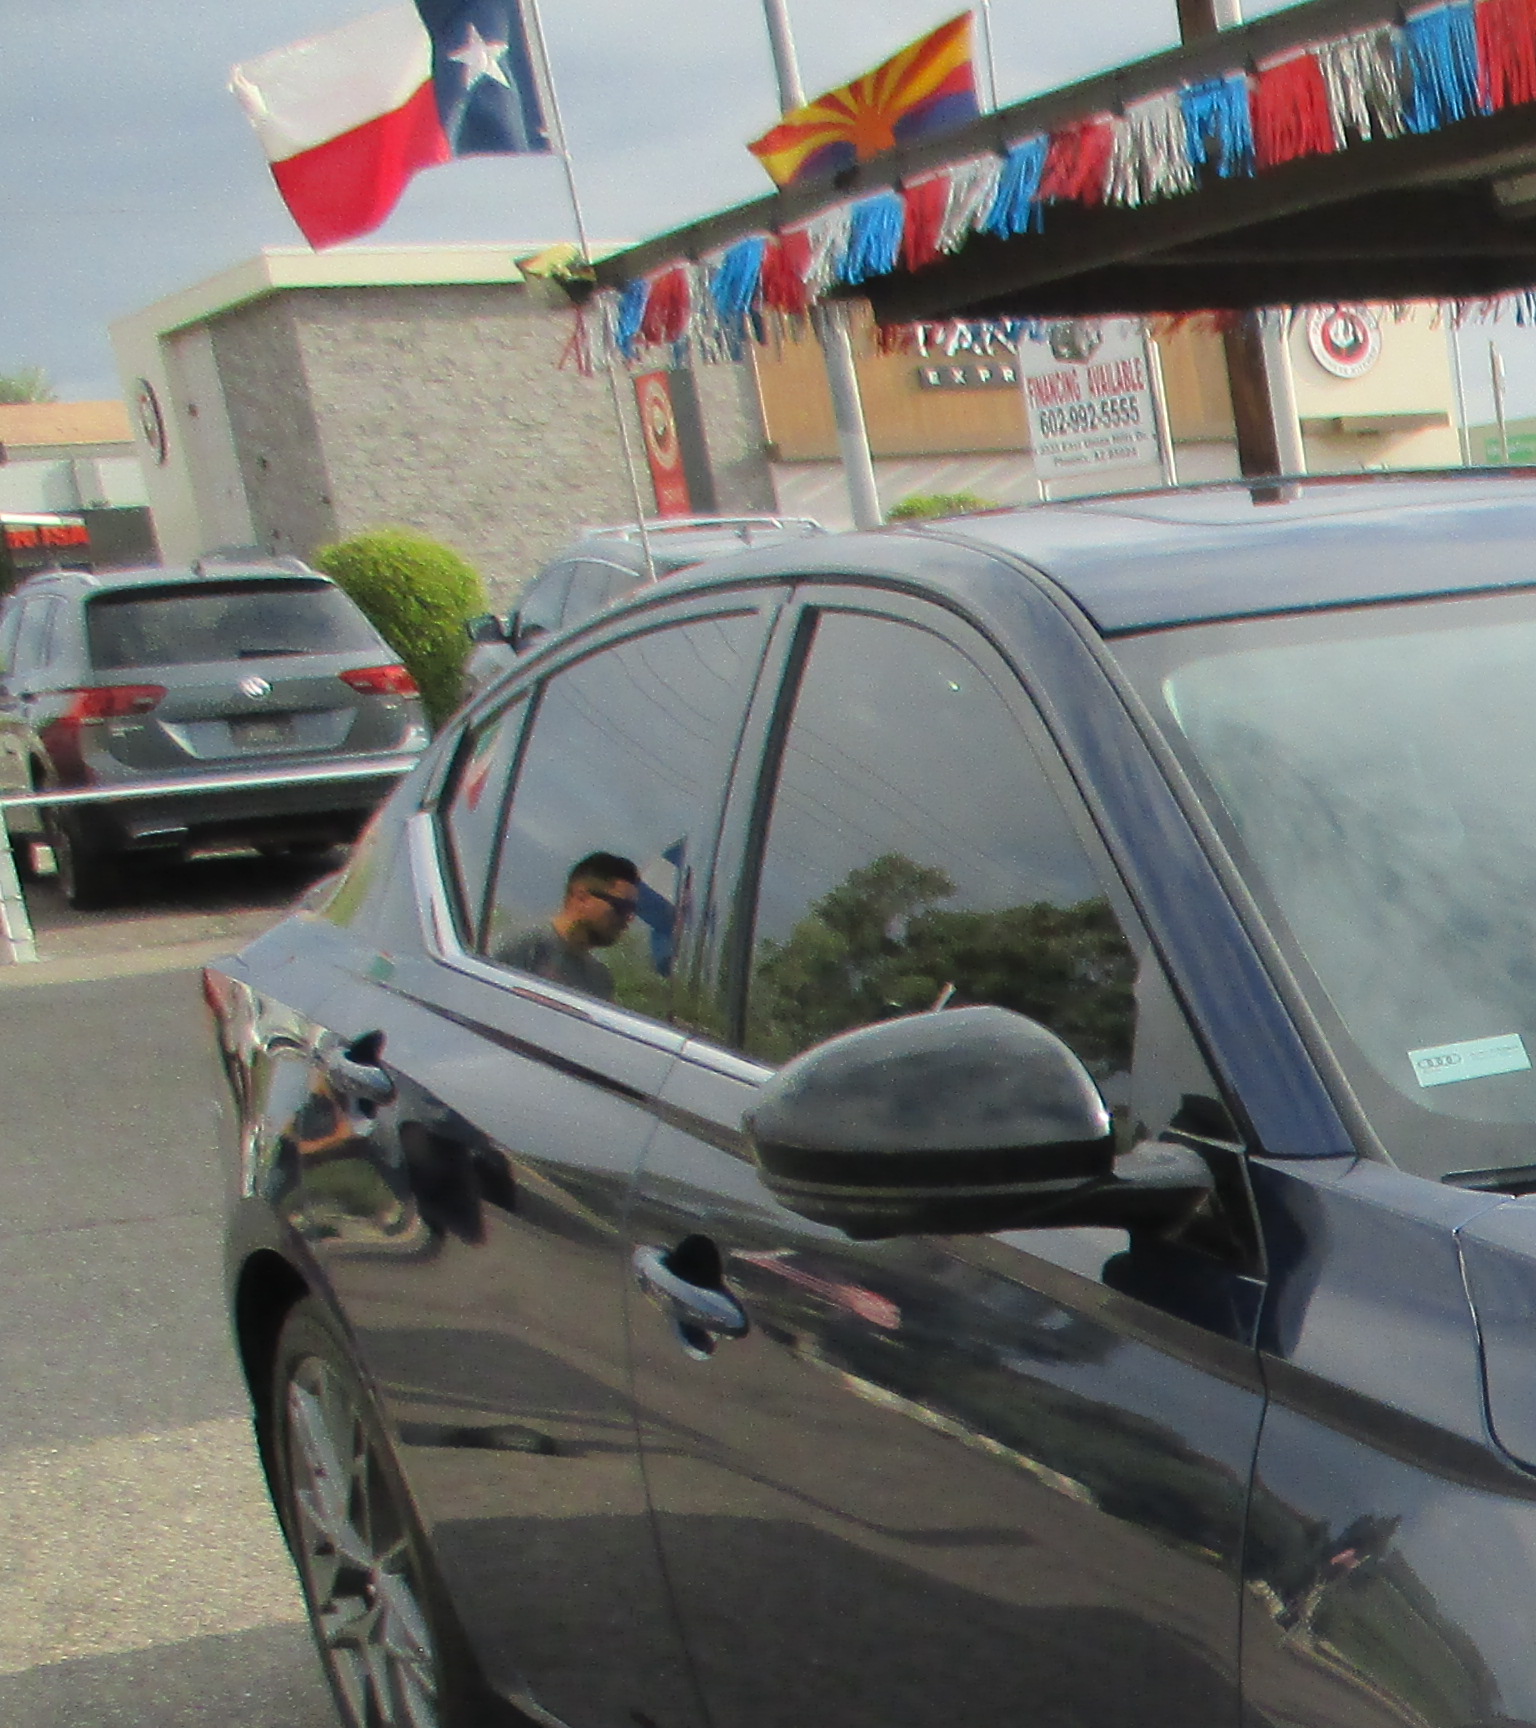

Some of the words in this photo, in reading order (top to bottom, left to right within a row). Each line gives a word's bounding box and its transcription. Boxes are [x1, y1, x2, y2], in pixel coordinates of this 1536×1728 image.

[917, 320, 1018, 358] PAN
[926, 365, 1017, 385] EXPR
[1039, 394, 1141, 439] 602-992-5555
